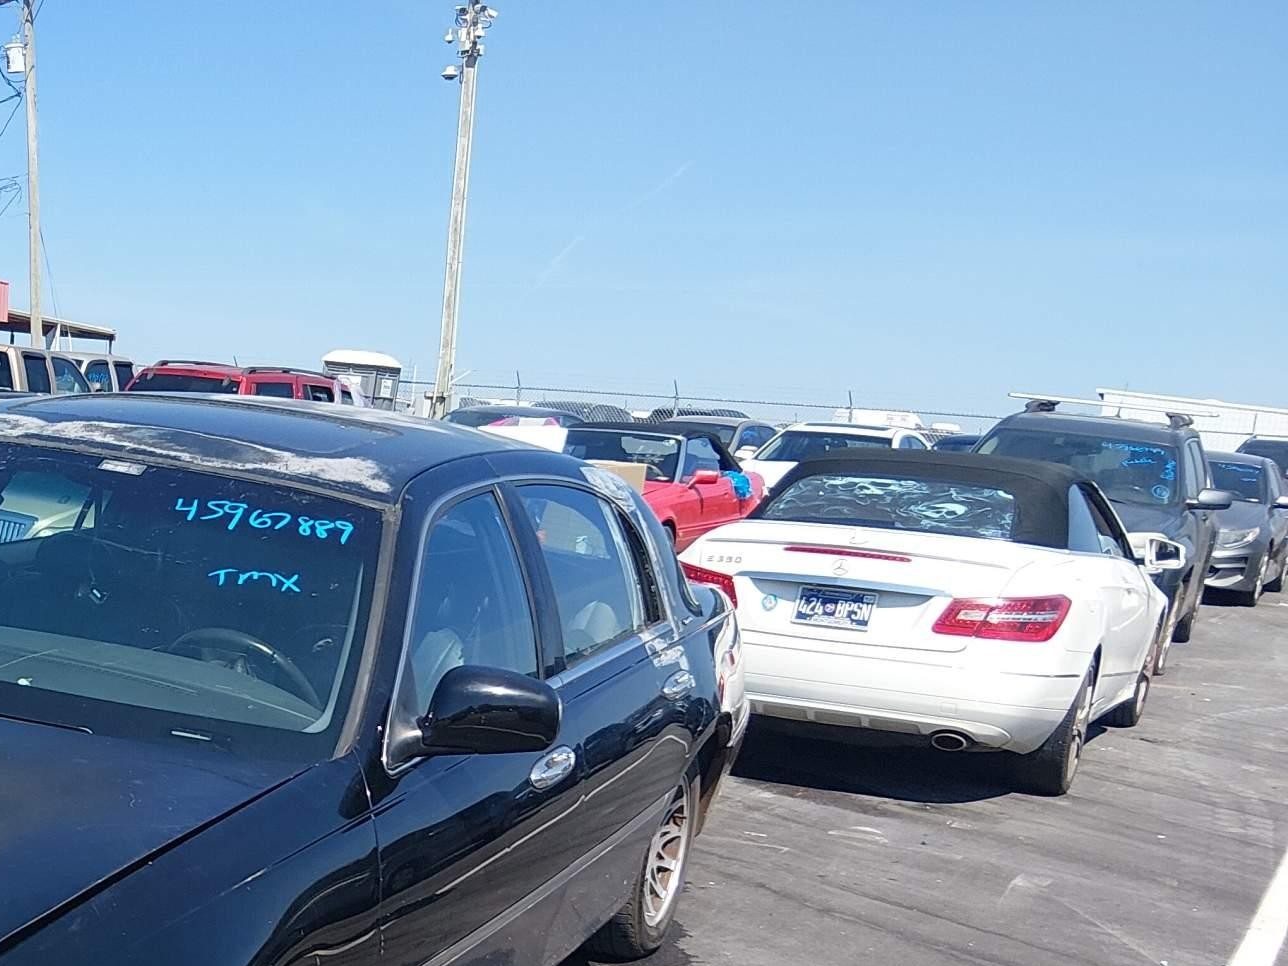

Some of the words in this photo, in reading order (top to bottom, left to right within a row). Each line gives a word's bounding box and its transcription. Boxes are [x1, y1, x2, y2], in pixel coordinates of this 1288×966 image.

[175, 498, 354, 544] 45967889
[208, 568, 301, 592] TMX
[798, 596, 824, 616] 424
